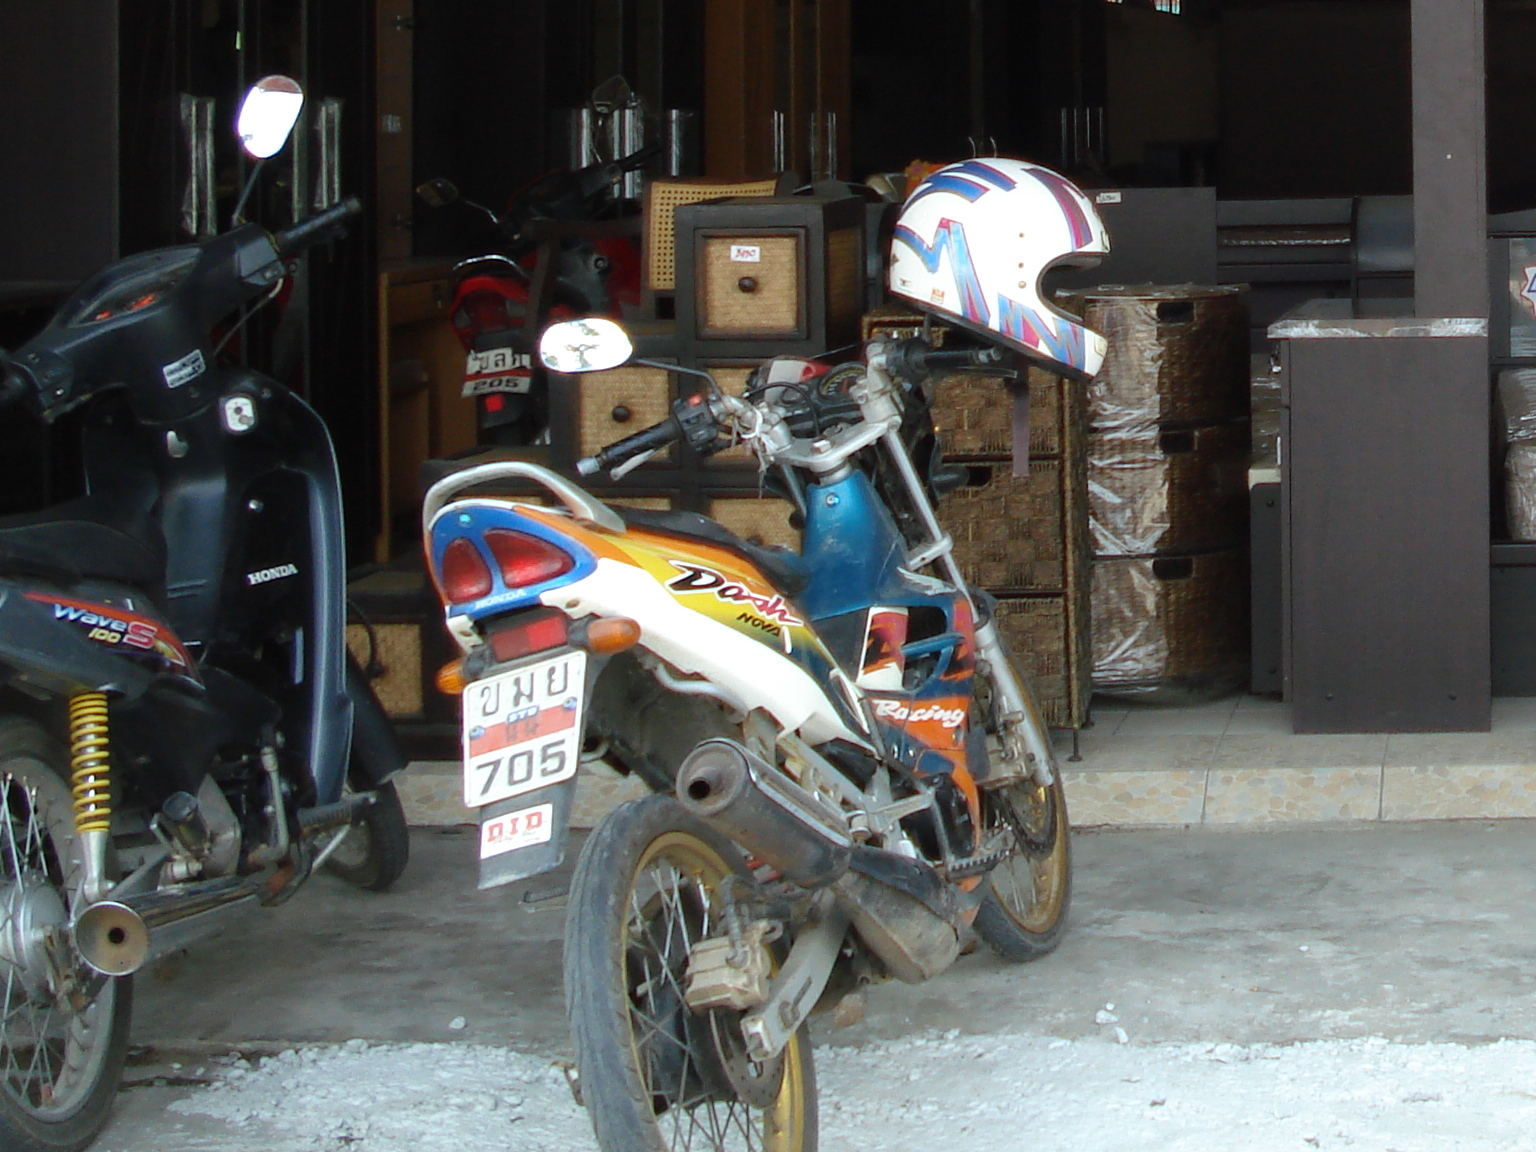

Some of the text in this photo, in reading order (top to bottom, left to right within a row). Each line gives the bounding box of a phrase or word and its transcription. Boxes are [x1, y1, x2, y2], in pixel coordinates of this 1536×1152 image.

[246, 563, 299, 587] HONDA
[474, 588, 527, 610] HONDA
[664, 559, 804, 626] Dash
[53, 602, 129, 633] Wave
[735, 611, 782, 638] NOVA
[87, 626, 122, 644] 100
[871, 698, 966, 729] Racing
[476, 738, 567, 797] 705
